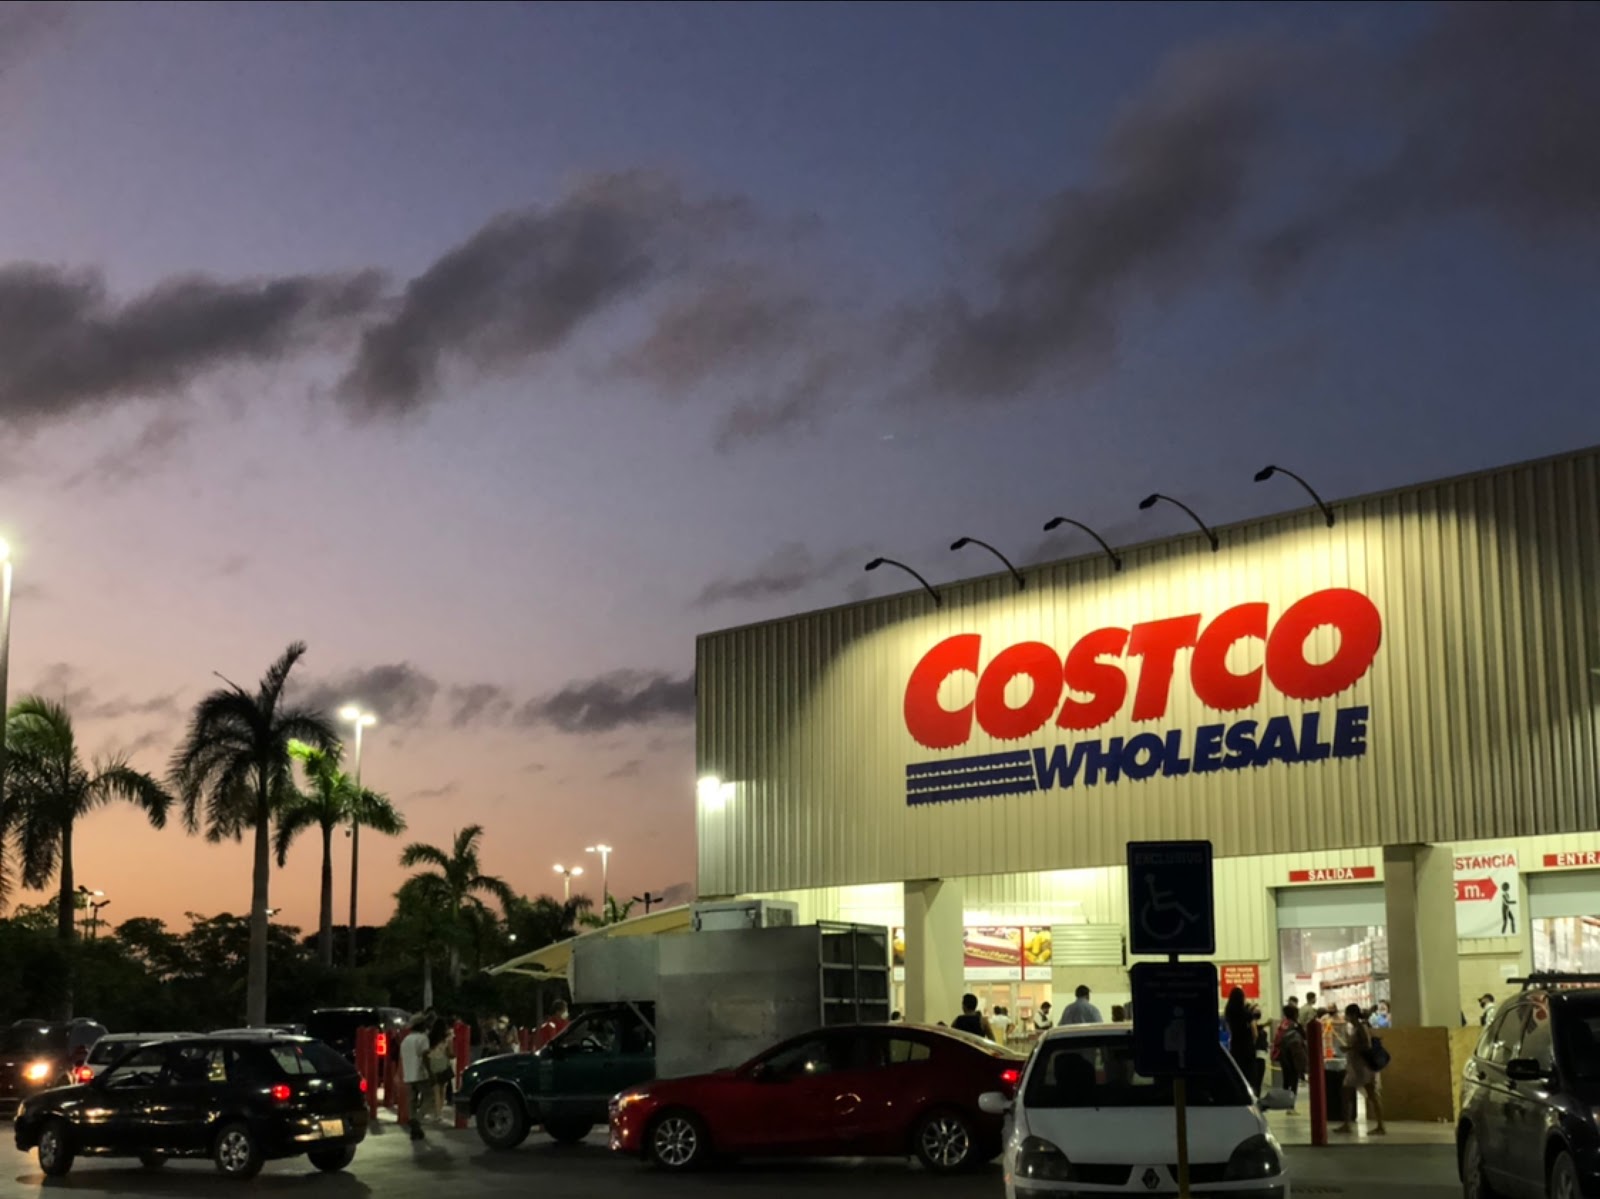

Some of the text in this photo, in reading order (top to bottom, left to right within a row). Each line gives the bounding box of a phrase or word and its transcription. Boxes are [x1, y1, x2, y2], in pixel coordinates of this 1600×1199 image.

[904, 588, 1382, 749] COSTCO
[1033, 706, 1368, 792] WHOLESALE
[1308, 868, 1354, 881] SALIDA
[1557, 851, 1600, 866] ENTR
